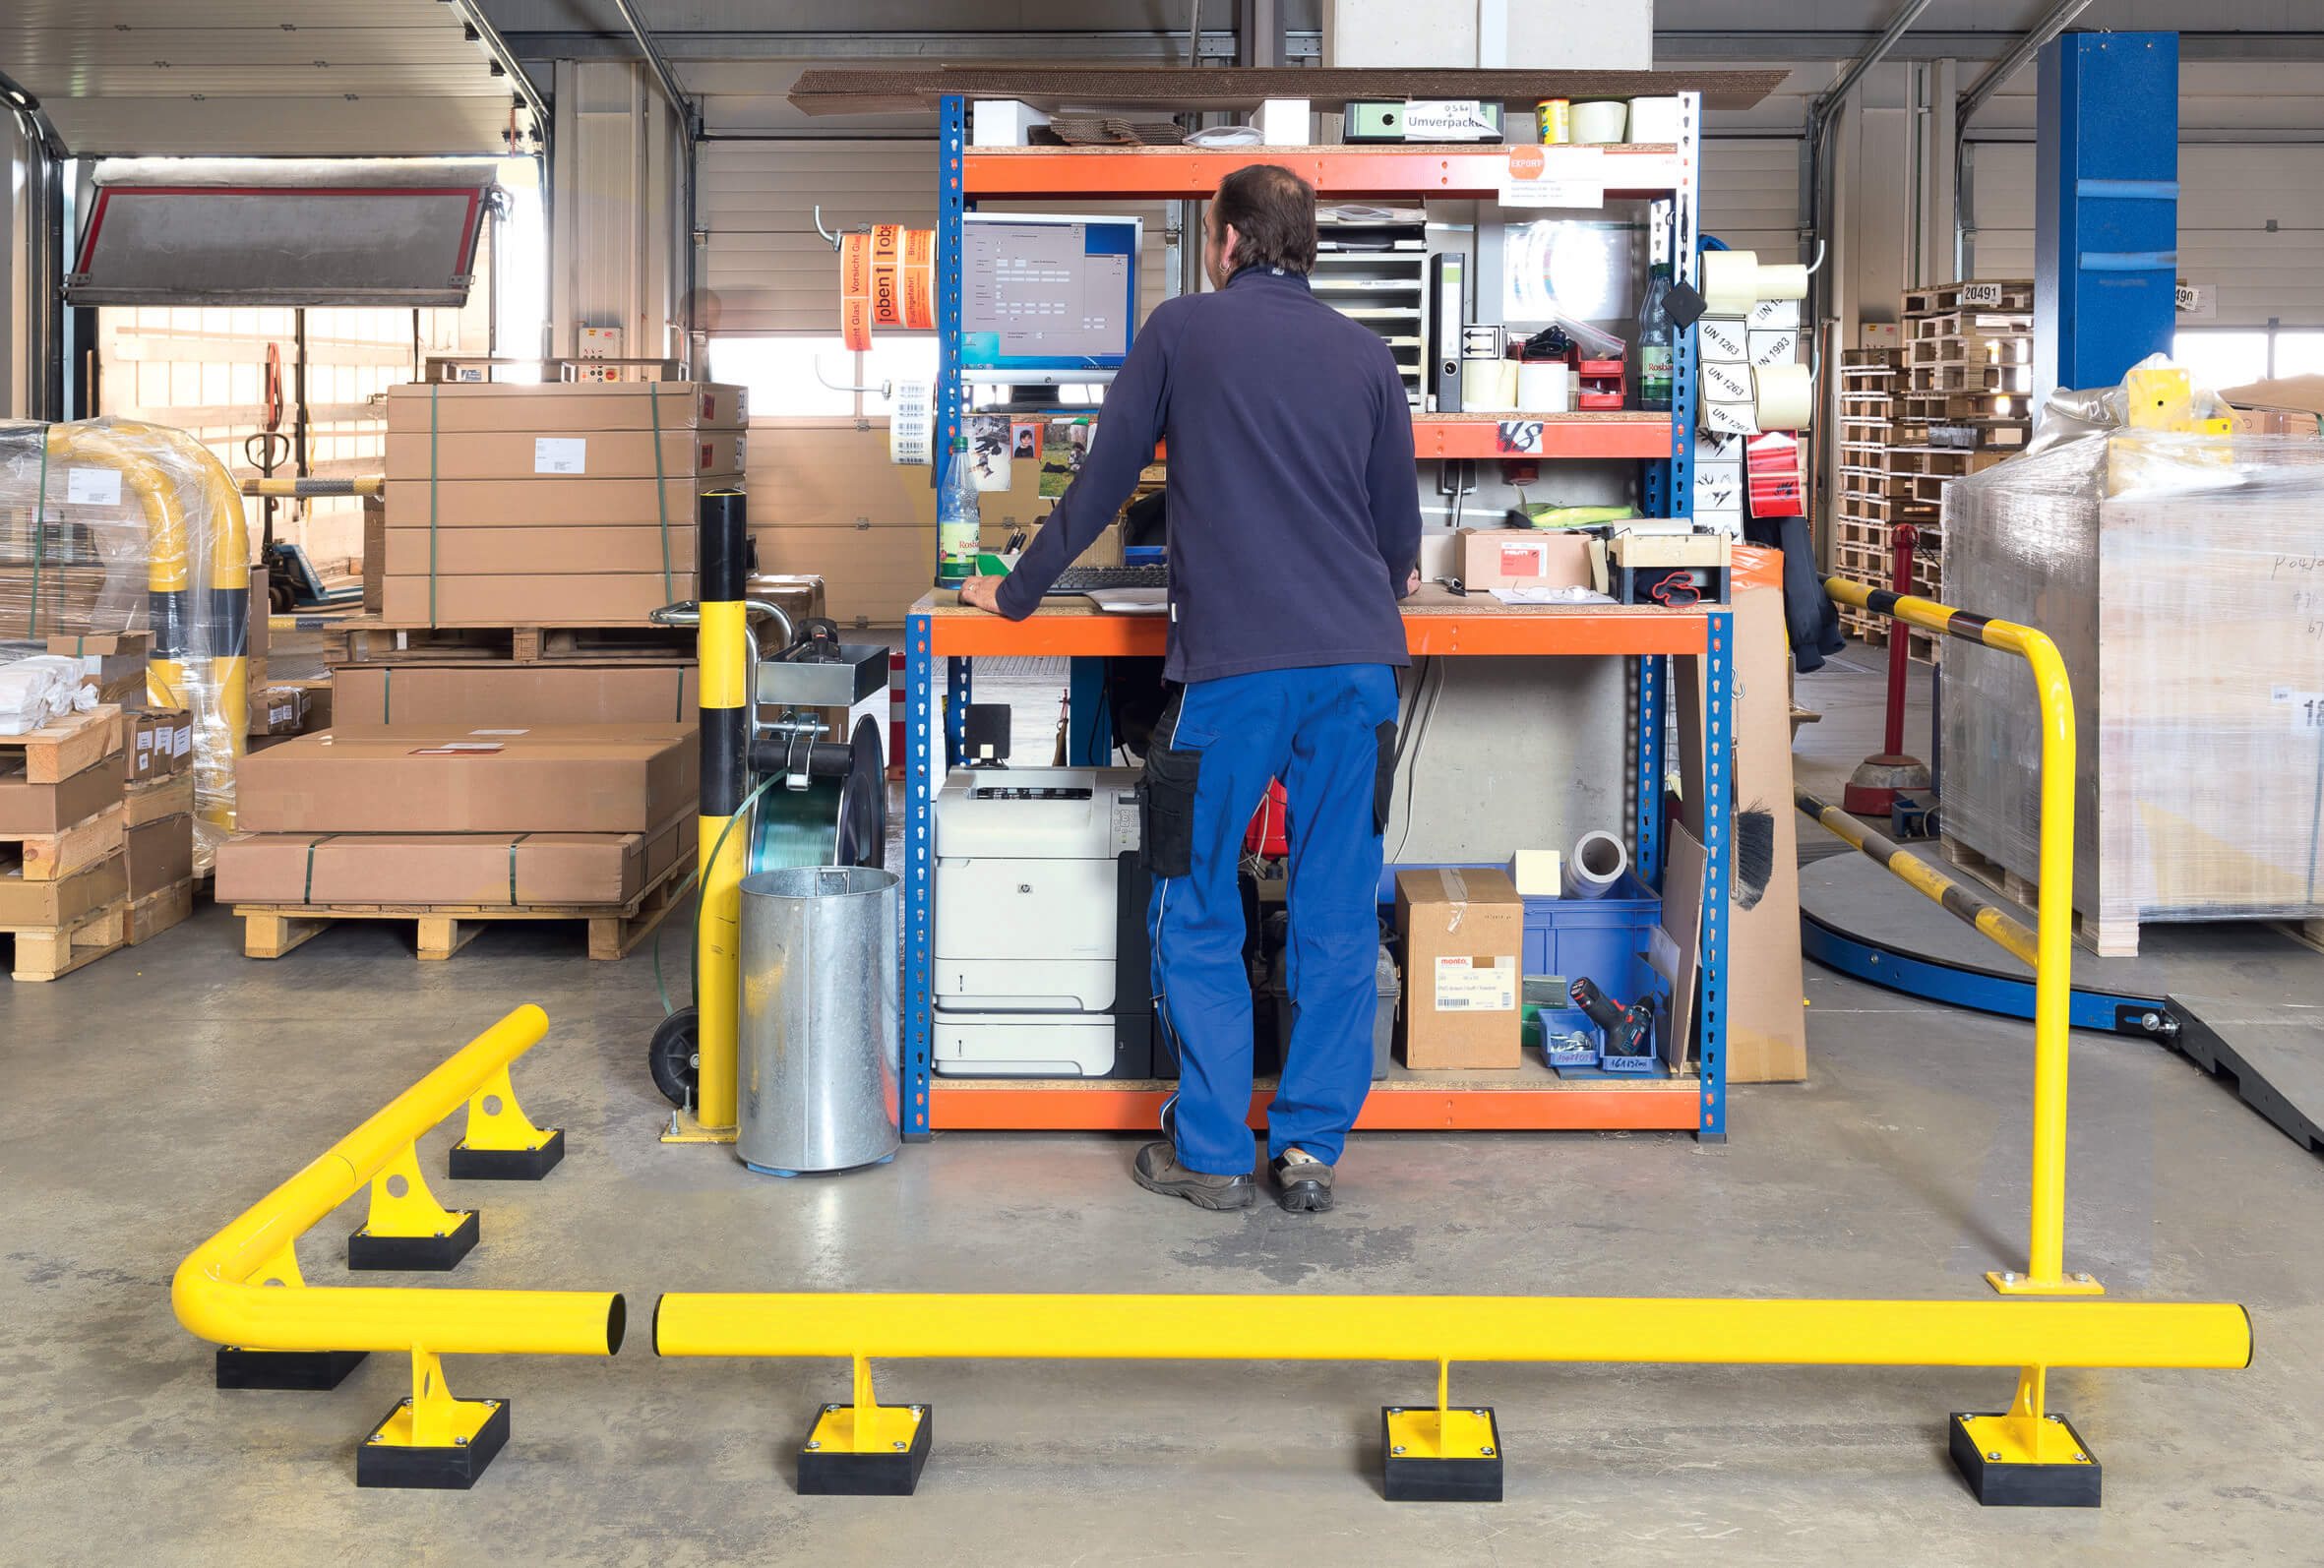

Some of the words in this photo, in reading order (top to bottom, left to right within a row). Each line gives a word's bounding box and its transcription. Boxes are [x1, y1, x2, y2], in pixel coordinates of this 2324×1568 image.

[1510, 158, 1543, 168] EXPORT
[851, 252, 861, 293] Vorsicht
[876, 276, 891, 318] oben
[1965, 286, 1996, 300] 20491
[851, 301, 861, 326] Glas!
[1756, 305, 1772, 321] UN
[1703, 325, 1720, 340] UN
[1718, 337, 1741, 356] 1263
[1769, 336, 1791, 359] 1993
[1707, 366, 1723, 382] UN
[1723, 378, 1744, 396] 1263
[1712, 407, 1728, 422] UN
